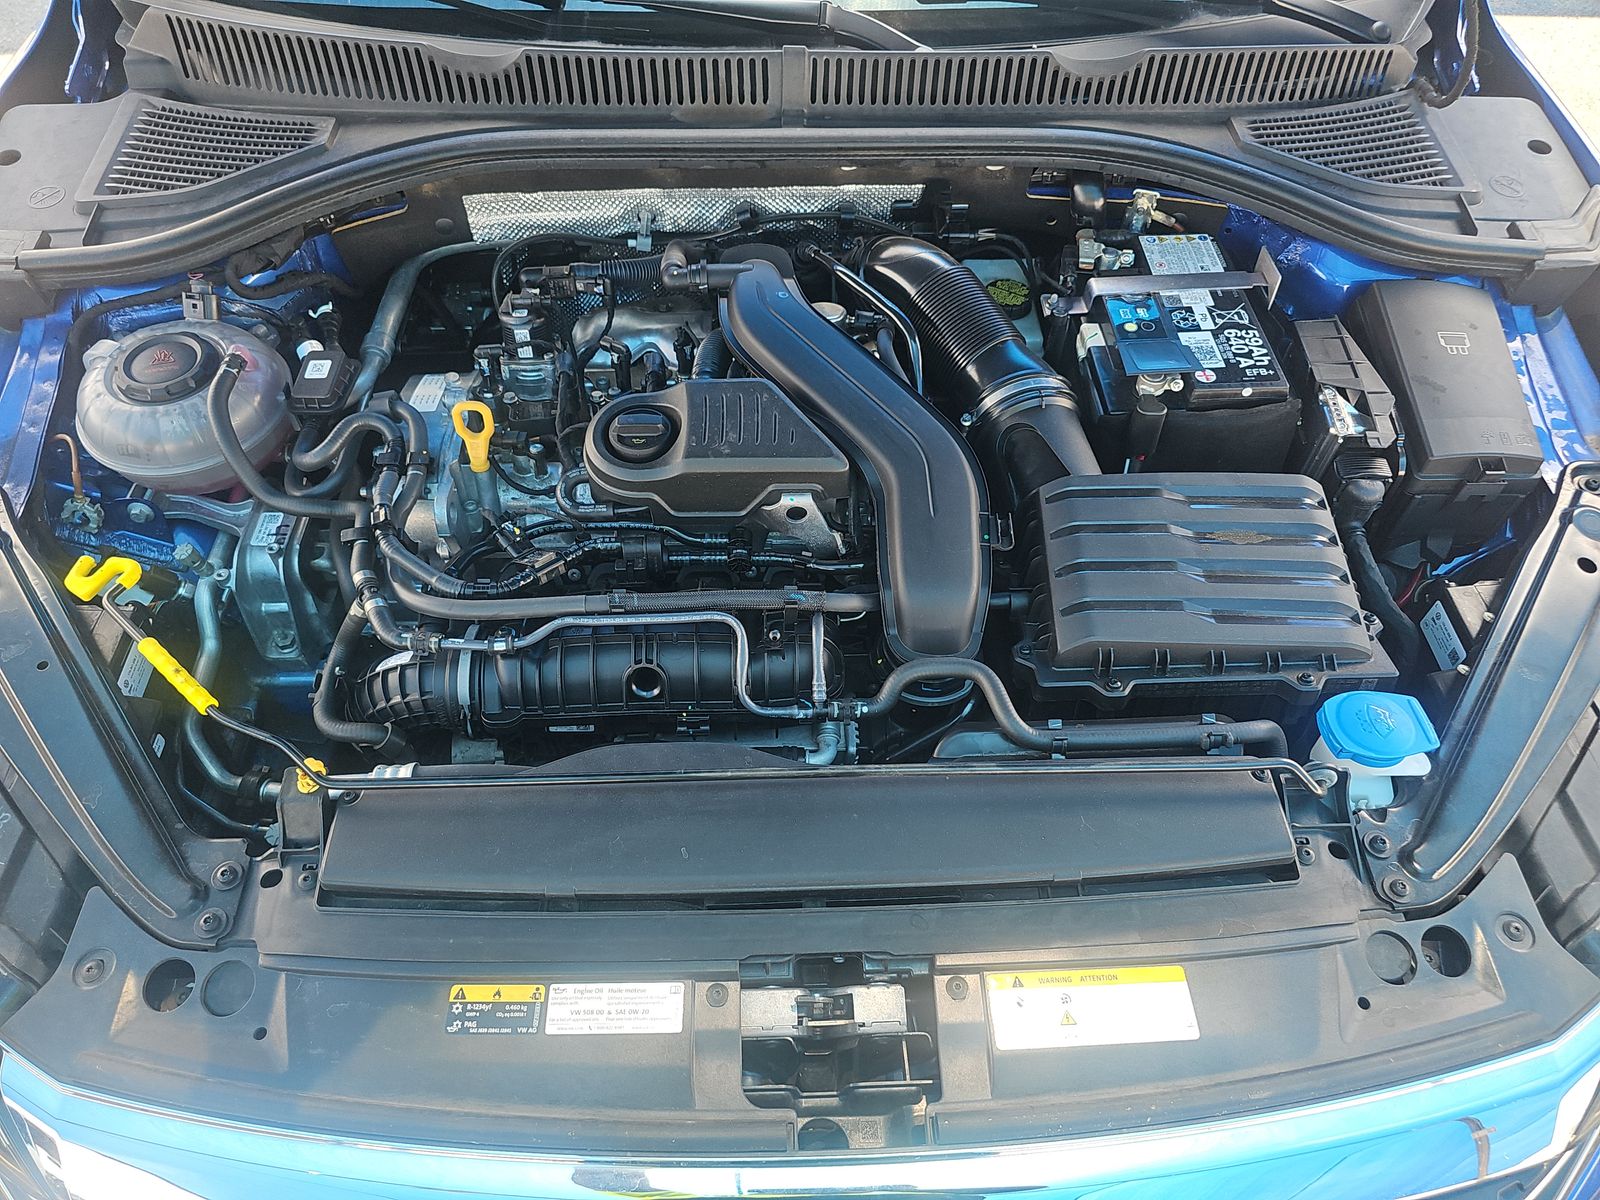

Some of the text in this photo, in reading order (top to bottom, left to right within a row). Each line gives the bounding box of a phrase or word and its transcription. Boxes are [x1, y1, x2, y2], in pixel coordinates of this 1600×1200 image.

[1223, 328, 1250, 354] 640
[1241, 329, 1272, 366] 59Ah
[1235, 356, 1255, 368] A
[1245, 368, 1275, 377] EFB+
[1038, 974, 1118, 984] WARNING ATTENTION
[573, 987, 594, 995] Engine
[466, 1003, 492, 1012] R-1234yf
[463, 1020, 477, 1028] PAG
